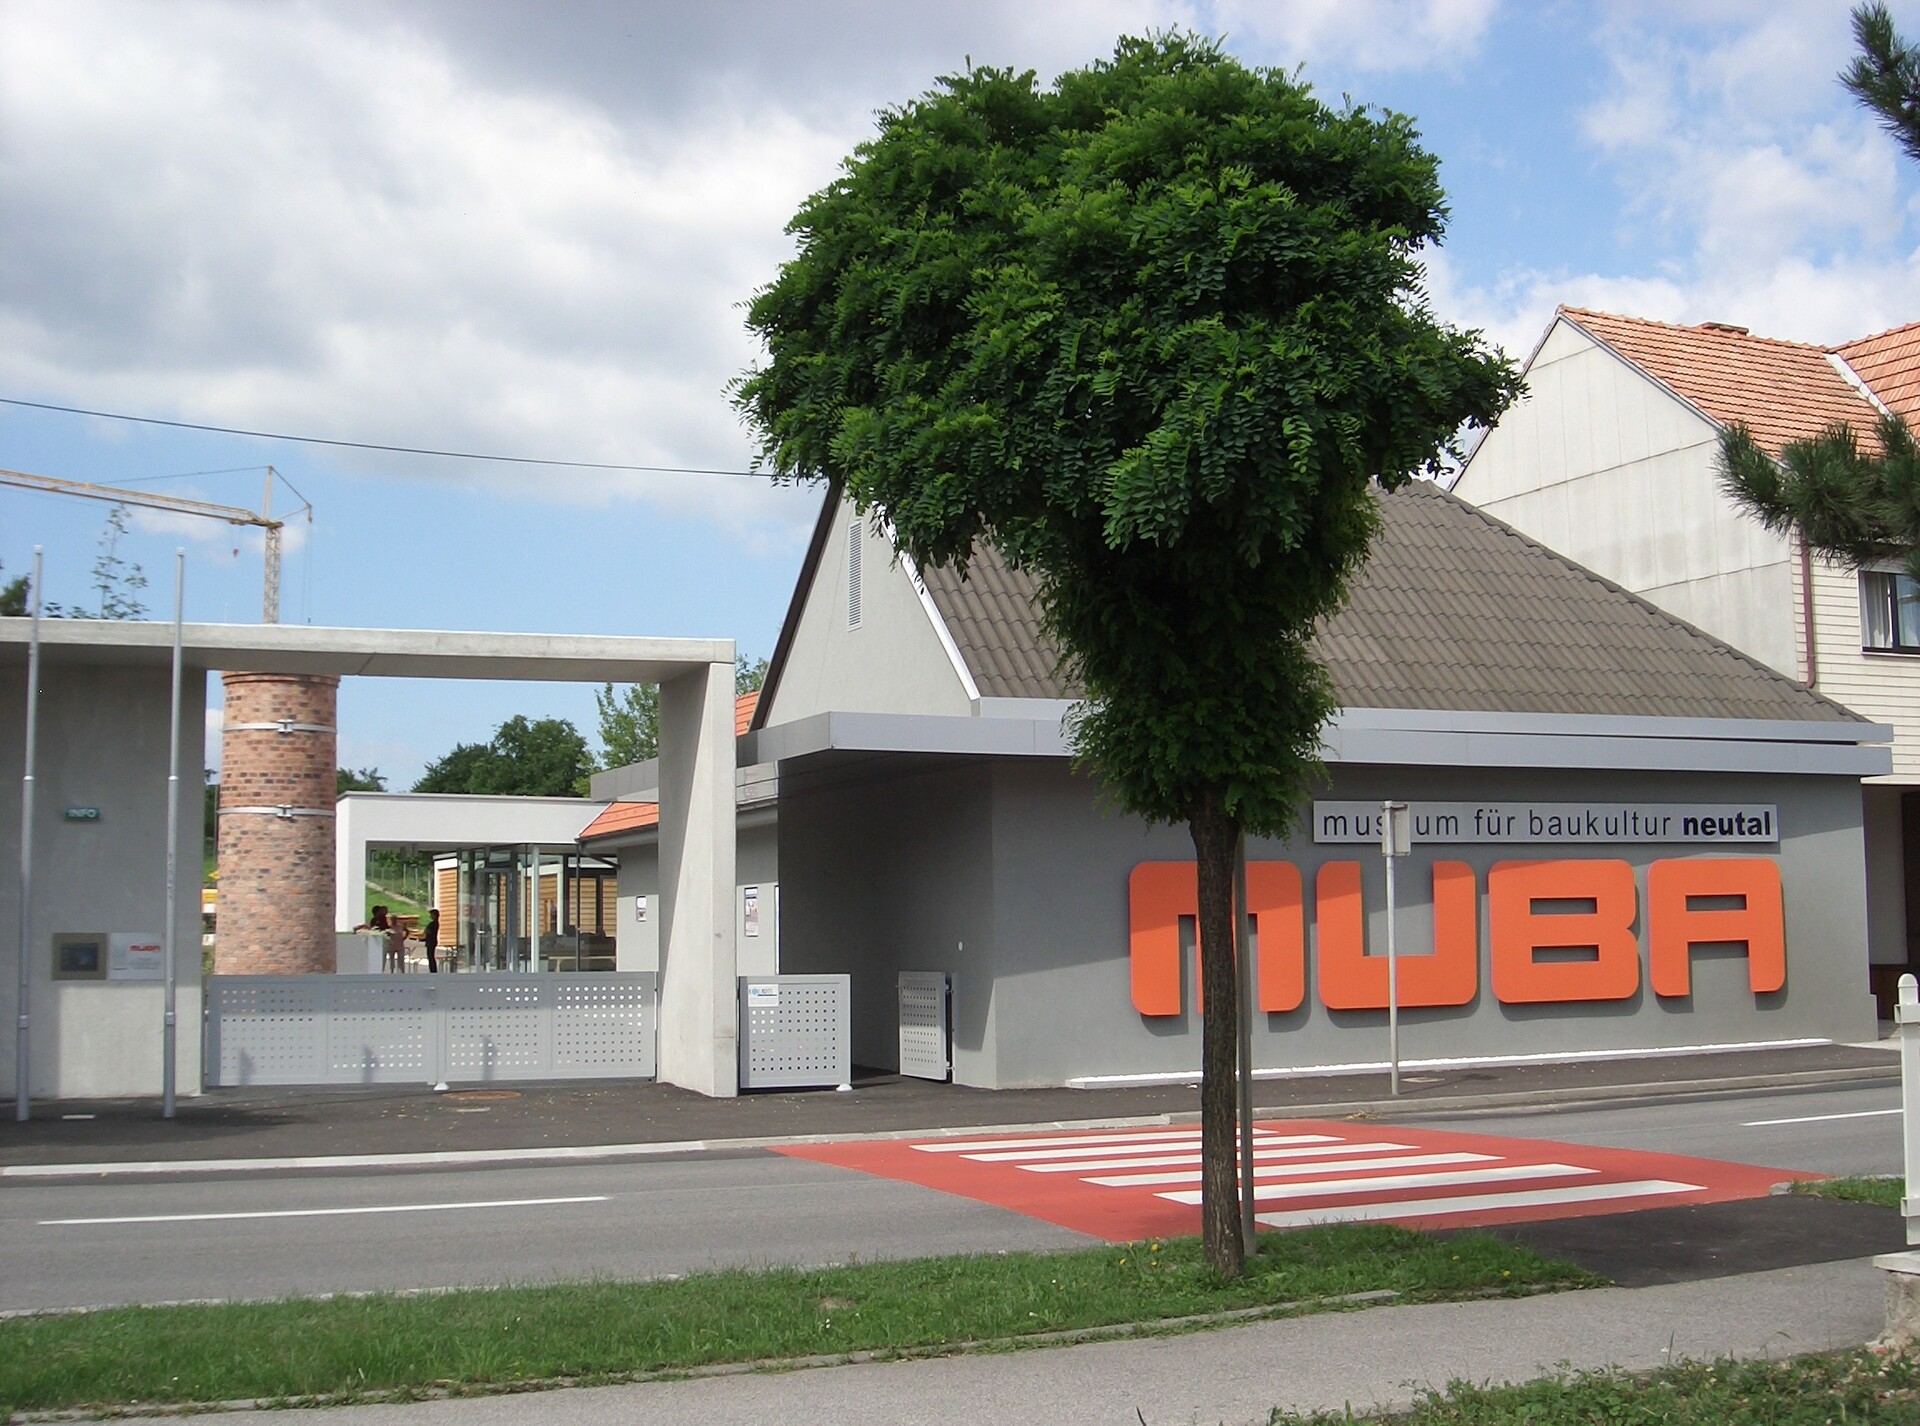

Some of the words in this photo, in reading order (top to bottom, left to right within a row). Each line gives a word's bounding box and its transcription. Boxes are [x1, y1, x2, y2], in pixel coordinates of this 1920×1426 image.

[1322, 815, 1460, 836] musum
[1474, 808, 1516, 836] für
[1529, 808, 1672, 836] baukultur
[1682, 811, 1772, 836] neutal
[1129, 858, 1786, 1015] MUBA
